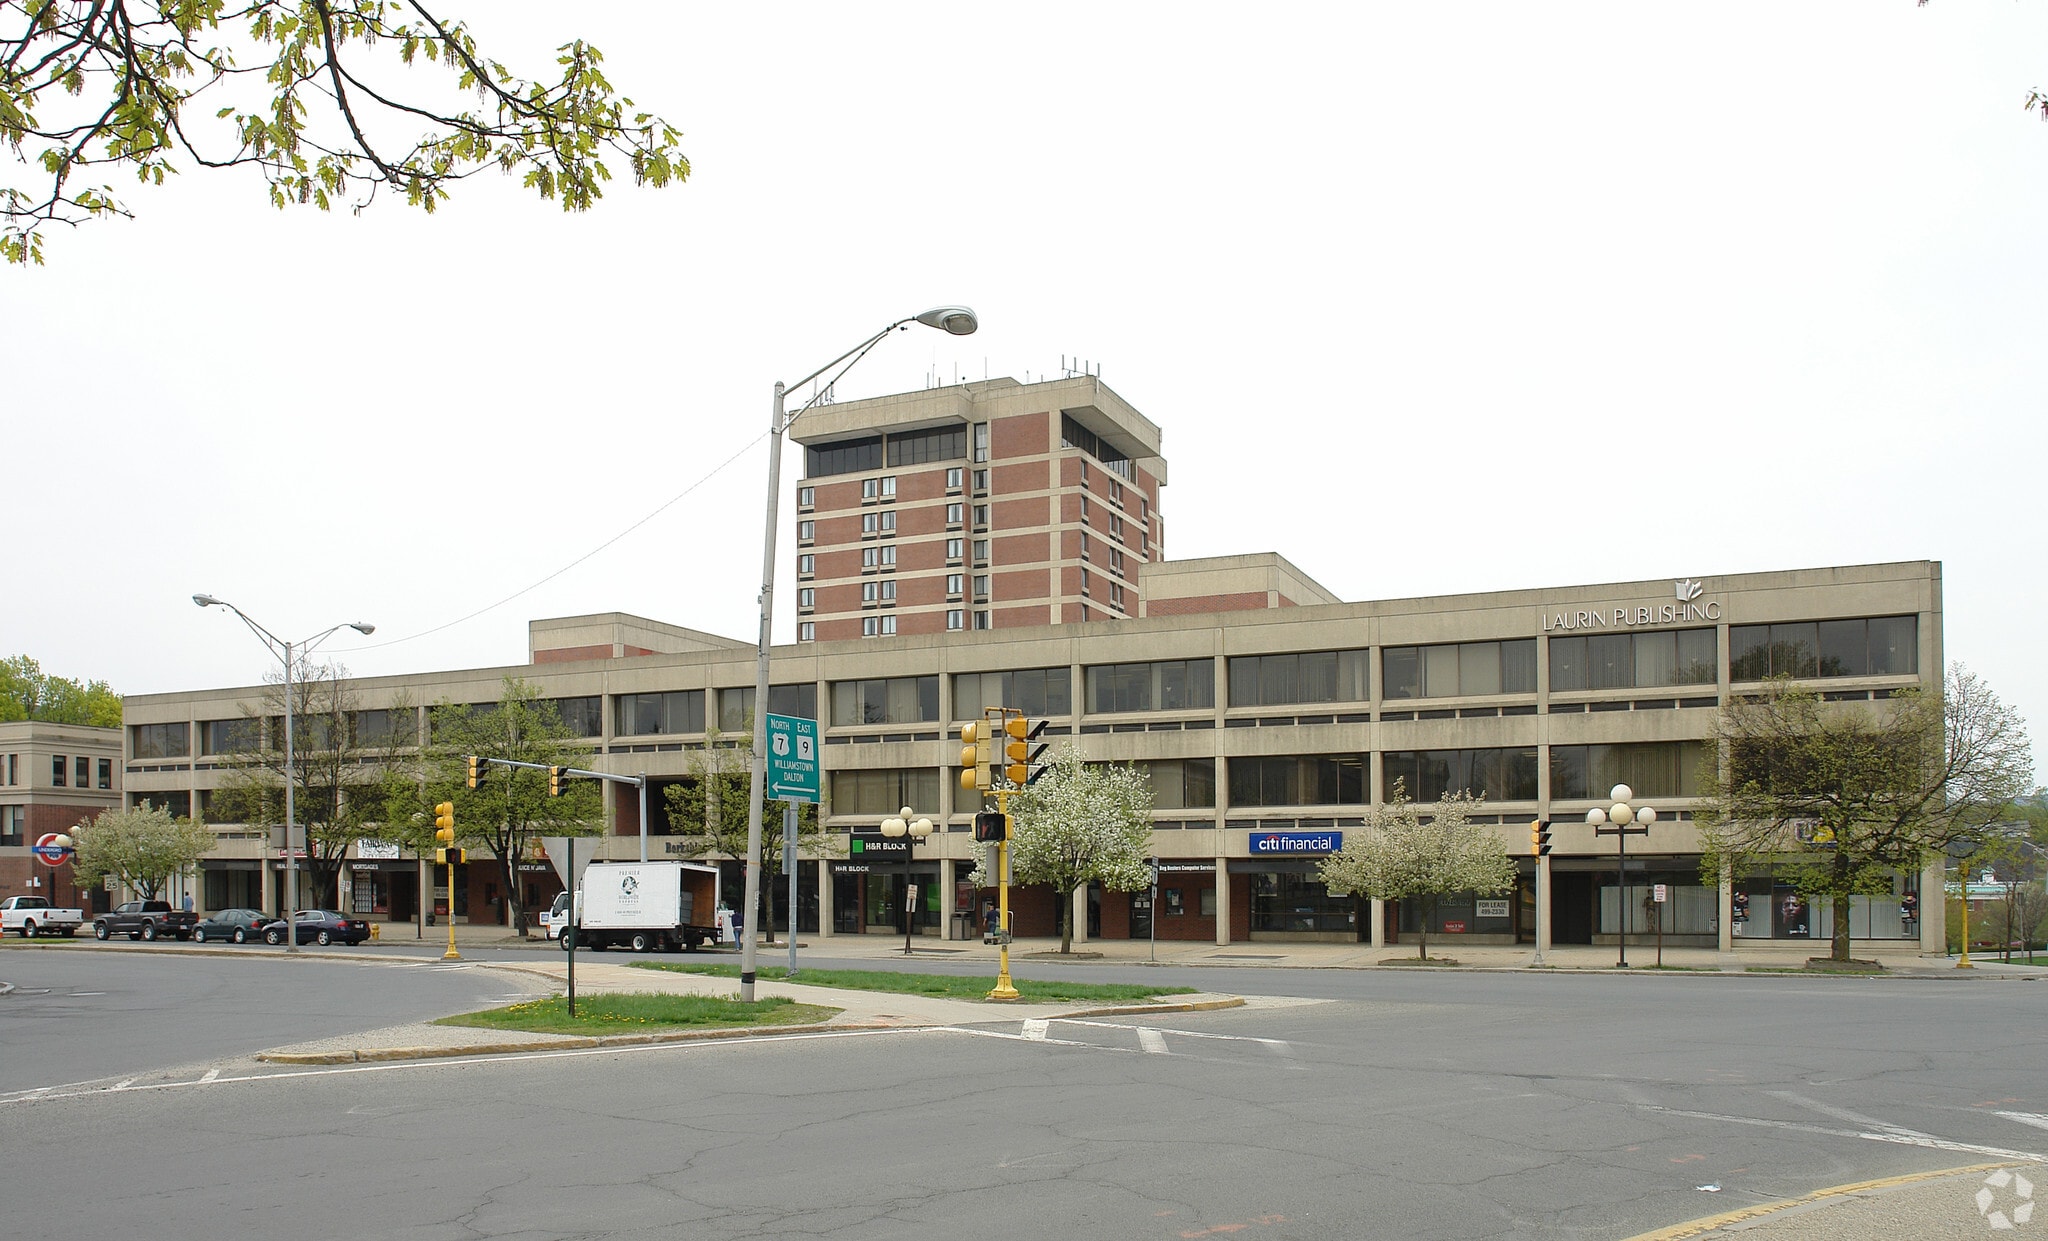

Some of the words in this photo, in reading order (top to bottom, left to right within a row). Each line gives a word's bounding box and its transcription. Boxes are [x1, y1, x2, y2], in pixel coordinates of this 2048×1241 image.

[1543, 610, 1606, 631] LAURIN
[1613, 601, 1721, 627] PUBLISHING
[770, 718, 790, 731] NORTH
[797, 722, 811, 734] EAST
[777, 737, 784, 751] 7
[802, 741, 809, 754] 9
[774, 759, 814, 772] WILLIAMSTOWN
[783, 772, 804, 783] DALTON
[865, 842, 881, 850] H&R
[883, 842, 906, 850] BLOCK
